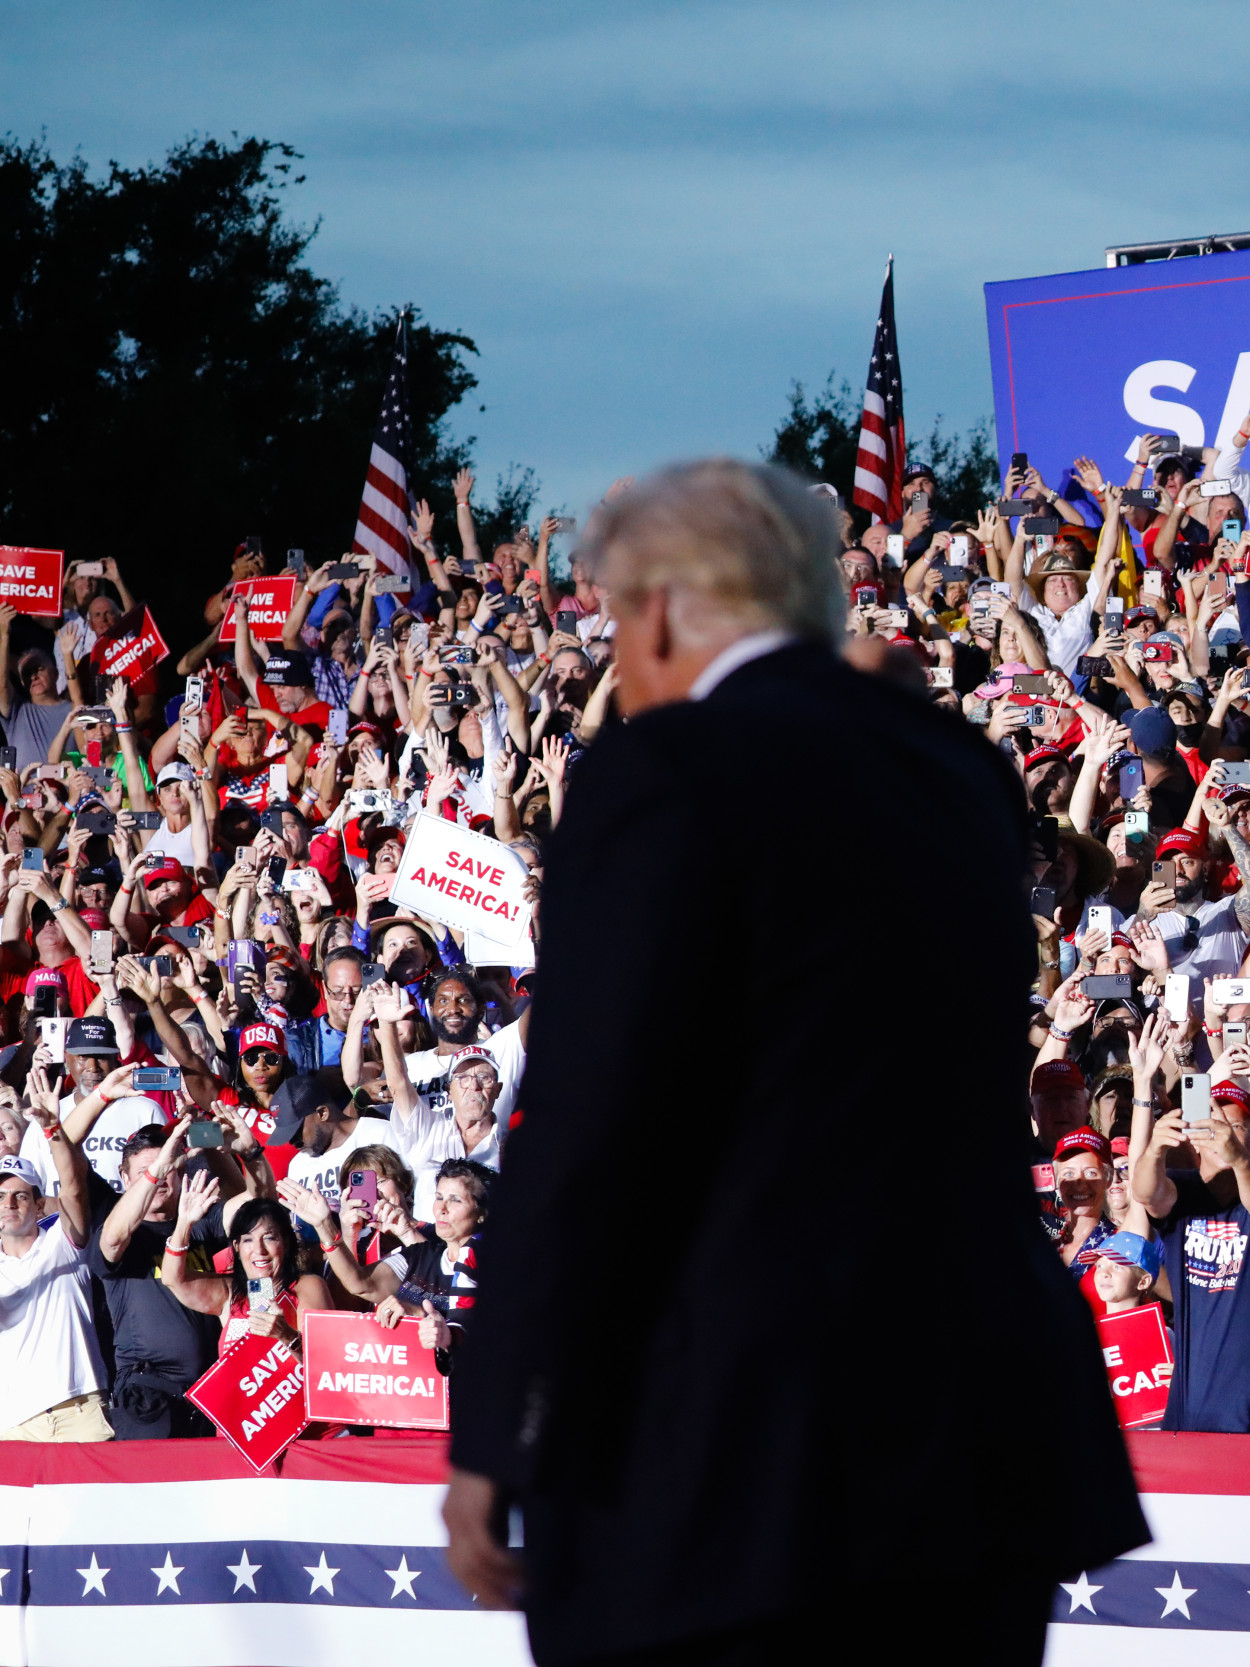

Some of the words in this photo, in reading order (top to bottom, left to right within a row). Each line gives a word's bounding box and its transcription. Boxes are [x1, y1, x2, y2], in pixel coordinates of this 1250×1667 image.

[0, 583, 53, 599] ERICA!
[250, 593, 274, 605] AVE
[228, 611, 287, 625] AERICA!
[104, 630, 136, 660] SAVE
[105, 634, 156, 675] MERICA!
[445, 850, 506, 887] SAVE
[411, 867, 520, 923] AMERICA!
[35, 973, 61, 984] MAGA
[245, 1026, 279, 1045] USA
[455, 1046, 491, 1060] FDNY
[237, 1106, 277, 1136] US
[86, 1137, 128, 1152] CKS
[1063, 1133, 1079, 1142] MAKE
[1064, 1139, 1082, 1147] GREAT
[1084, 1139, 1100, 1149] AGAIN
[3, 1159, 23, 1170] SA
[1185, 1230, 1249, 1261] TRUMP
[344, 1342, 407, 1366] SAVE
[239, 1340, 292, 1397] SAVE
[317, 1371, 434, 1398] AMERICA!
[241, 1362, 303, 1442] AMERIC
